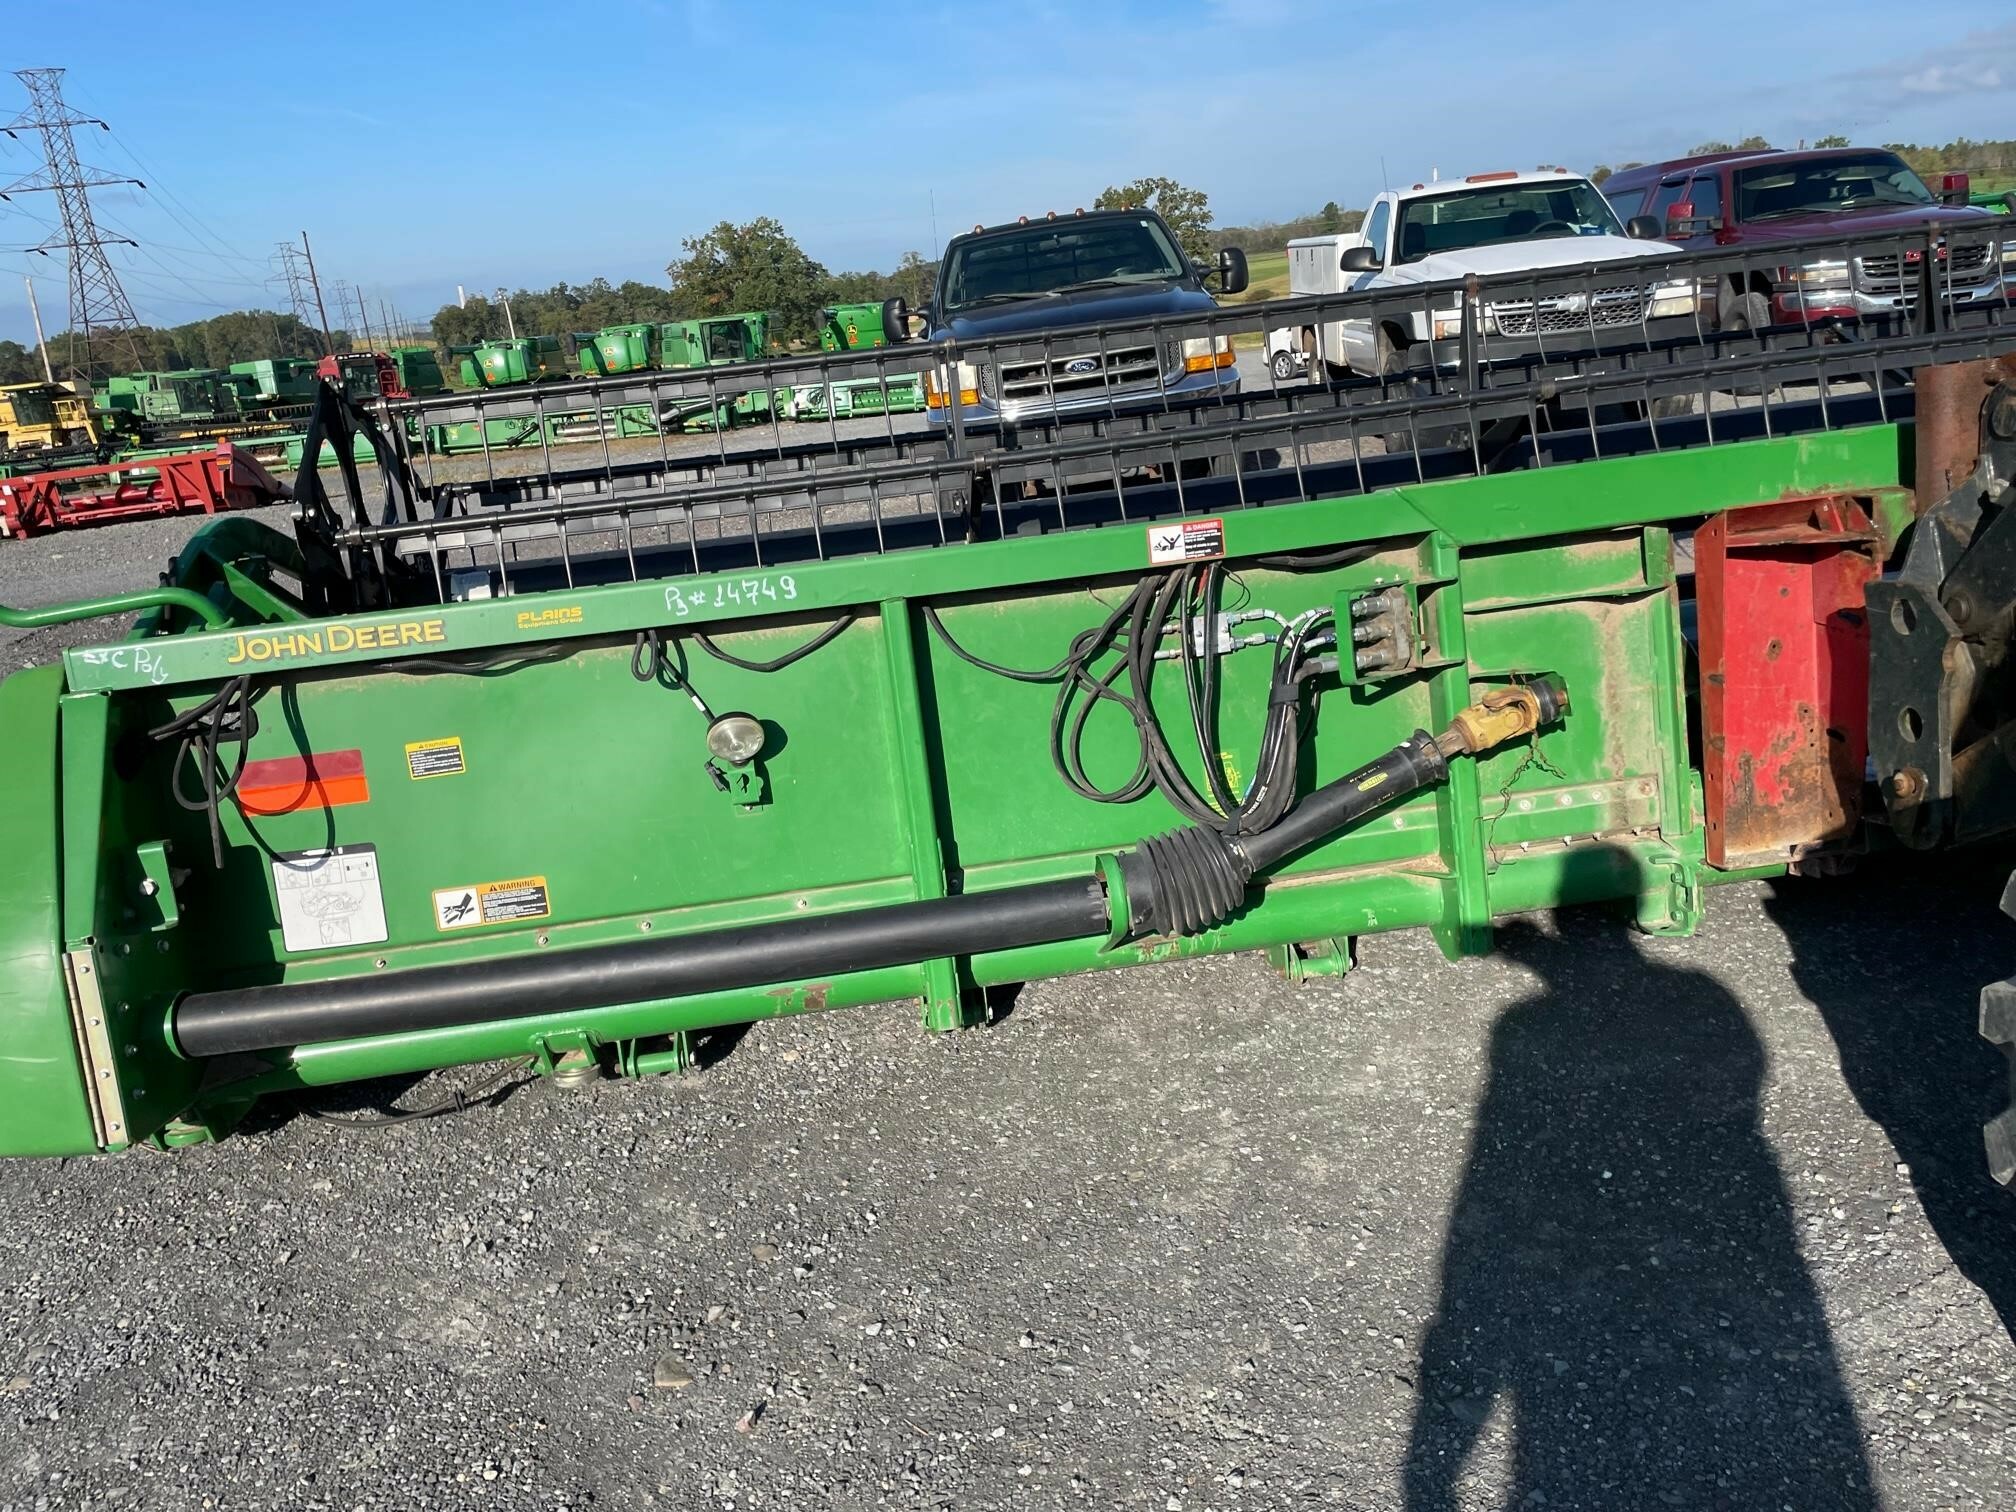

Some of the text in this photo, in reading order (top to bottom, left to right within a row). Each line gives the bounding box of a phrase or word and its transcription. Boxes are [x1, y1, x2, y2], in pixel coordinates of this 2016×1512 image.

[517, 606, 582, 623] PLAINS
[228, 619, 445, 664] JOHN DEERE
[498, 880, 536, 891] WARNING
